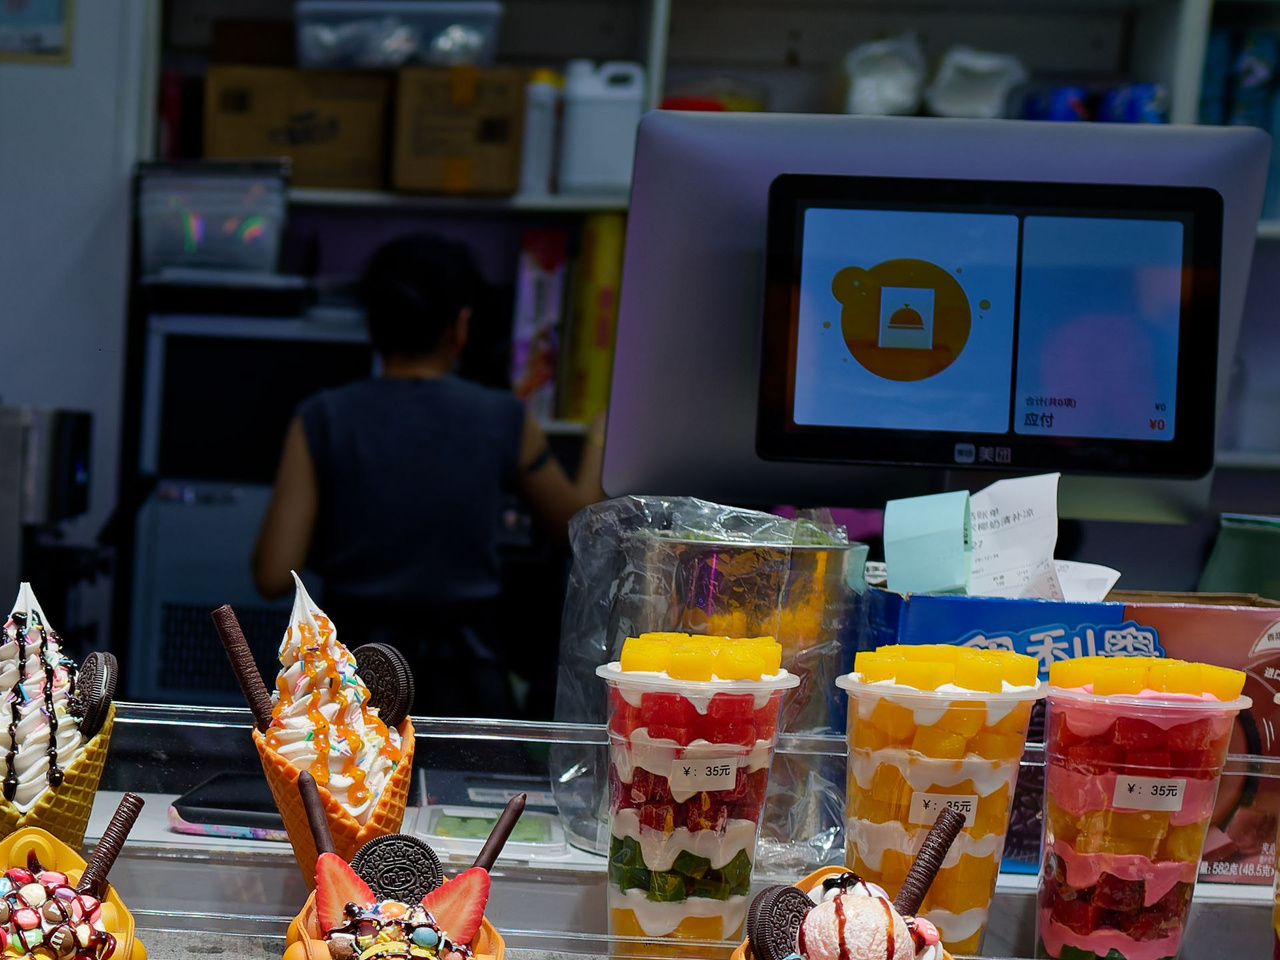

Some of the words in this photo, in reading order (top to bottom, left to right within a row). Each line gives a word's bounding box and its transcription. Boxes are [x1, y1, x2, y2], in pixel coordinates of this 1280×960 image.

[1024, 412, 1054, 428] 应付
[1149, 418, 1166, 431] ¥0
[705, 764, 731, 777] 35元
[1150, 785, 1178, 797] 35元
[946, 801, 972, 813] 35元
